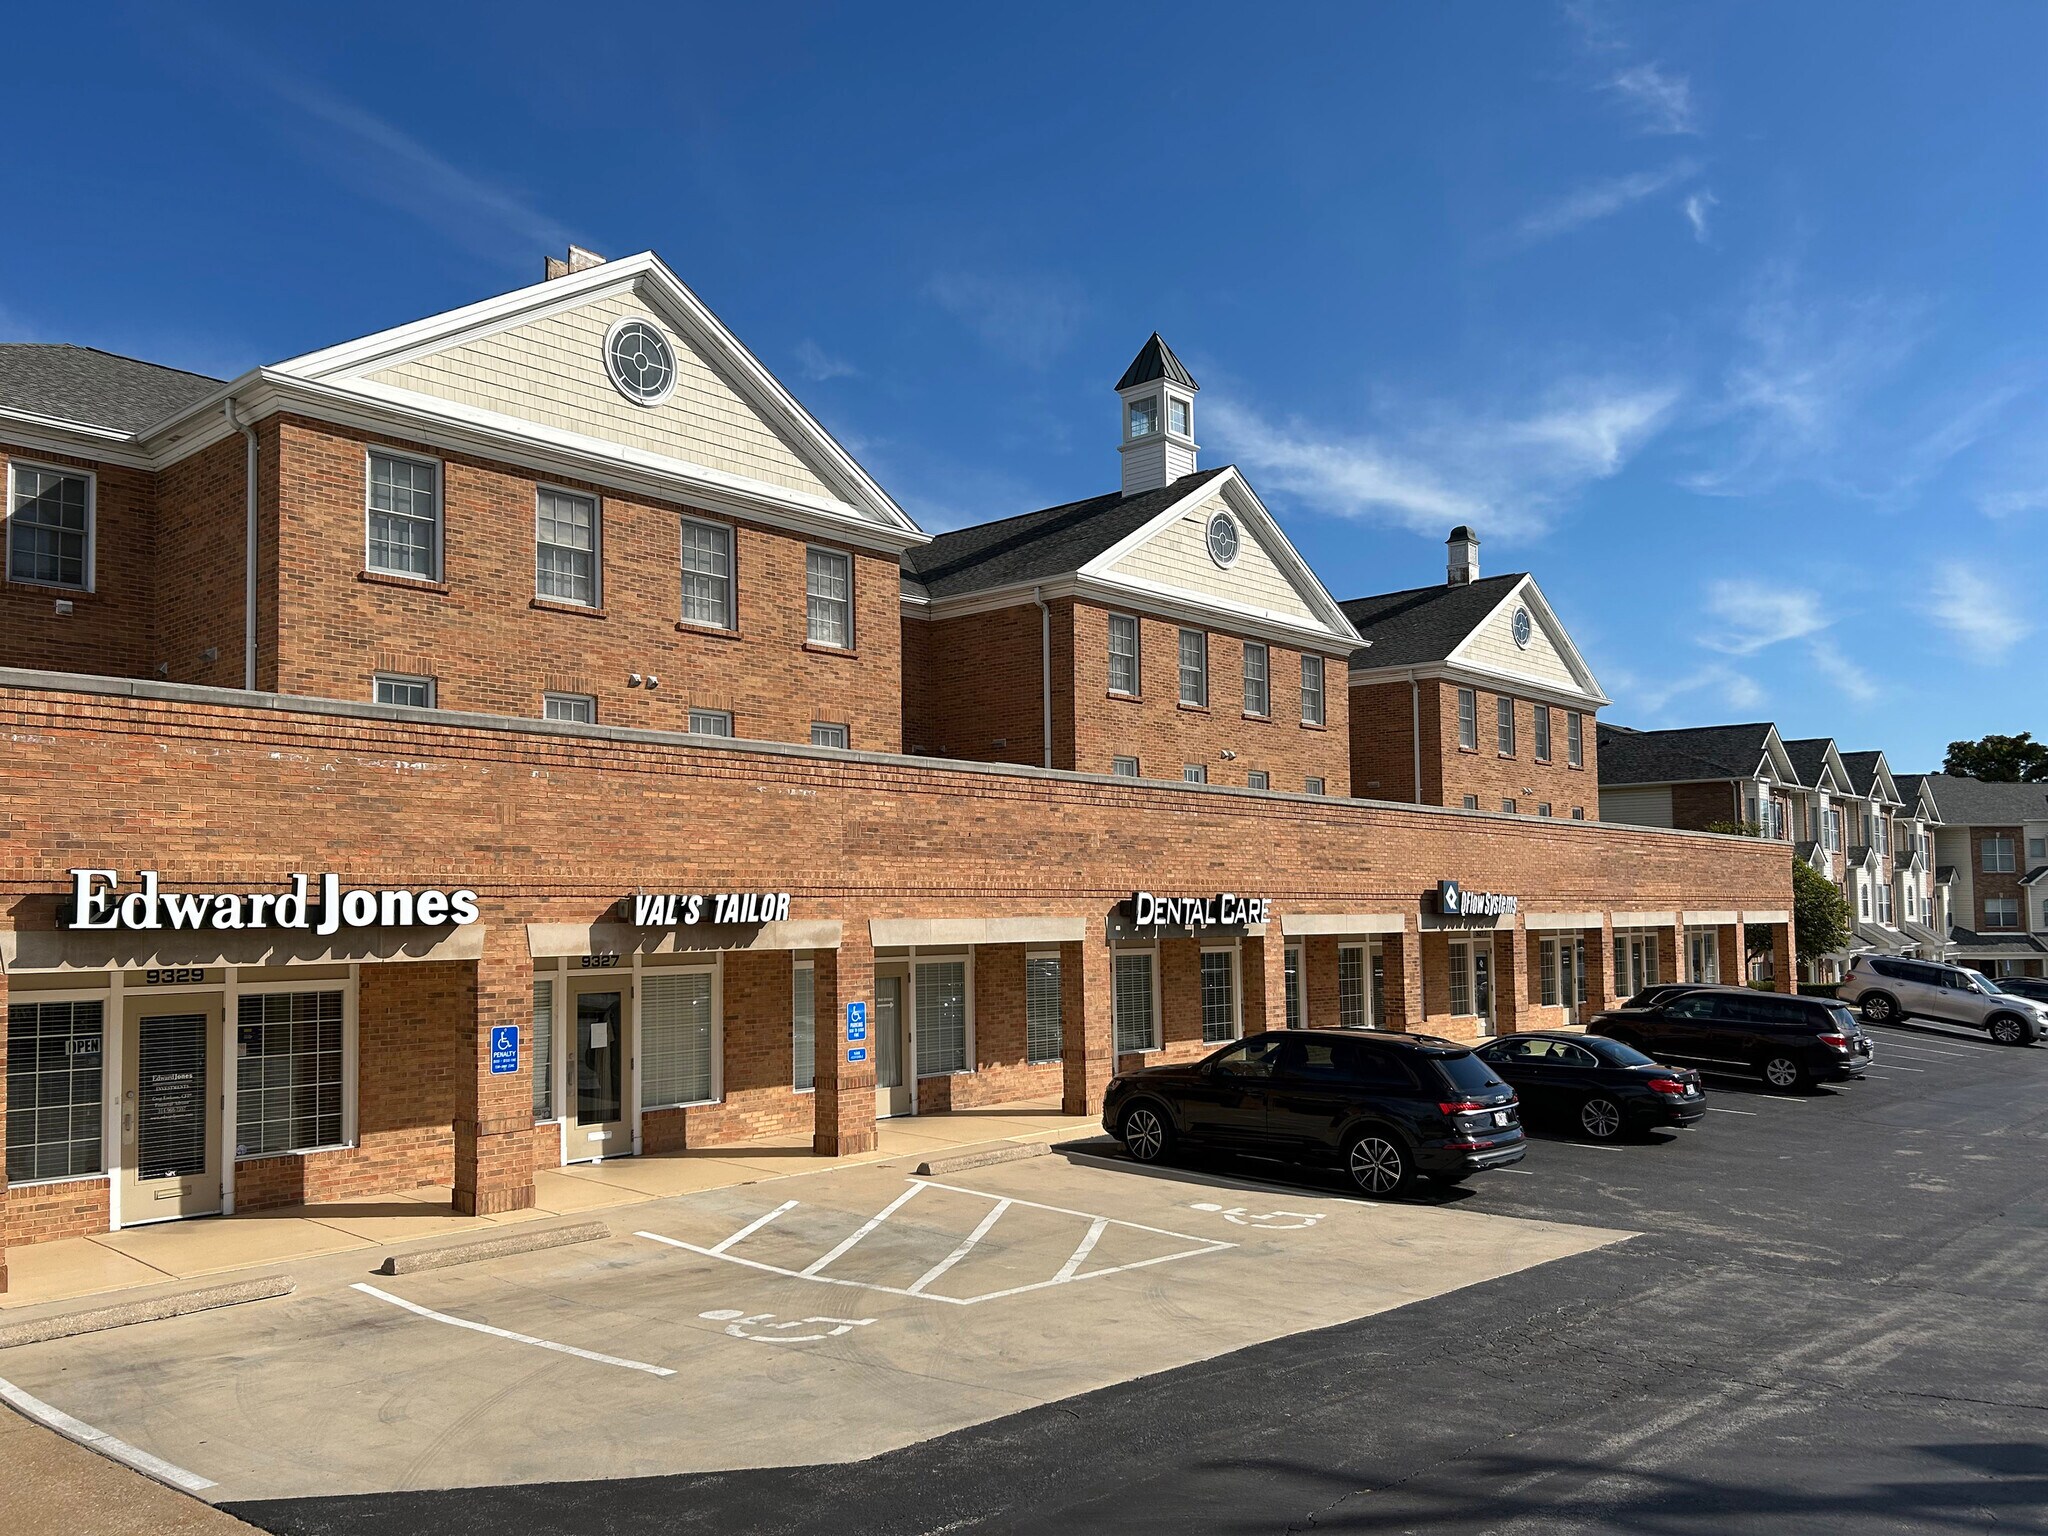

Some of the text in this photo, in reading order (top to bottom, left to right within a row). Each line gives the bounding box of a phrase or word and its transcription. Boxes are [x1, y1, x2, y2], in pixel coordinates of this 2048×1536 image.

[635, 893, 790, 926] VAL'S TAILOR
[1136, 892, 1272, 925] DENTAL CARE
[1460, 891, 1485, 916] QFlow
[1484, 891, 1517, 916] Systems
[581, 955, 620, 967] 9327
[146, 968, 205, 984] 9329
[68, 1039, 99, 1054] OPEN
[493, 1050, 517, 1058] PENALTY
